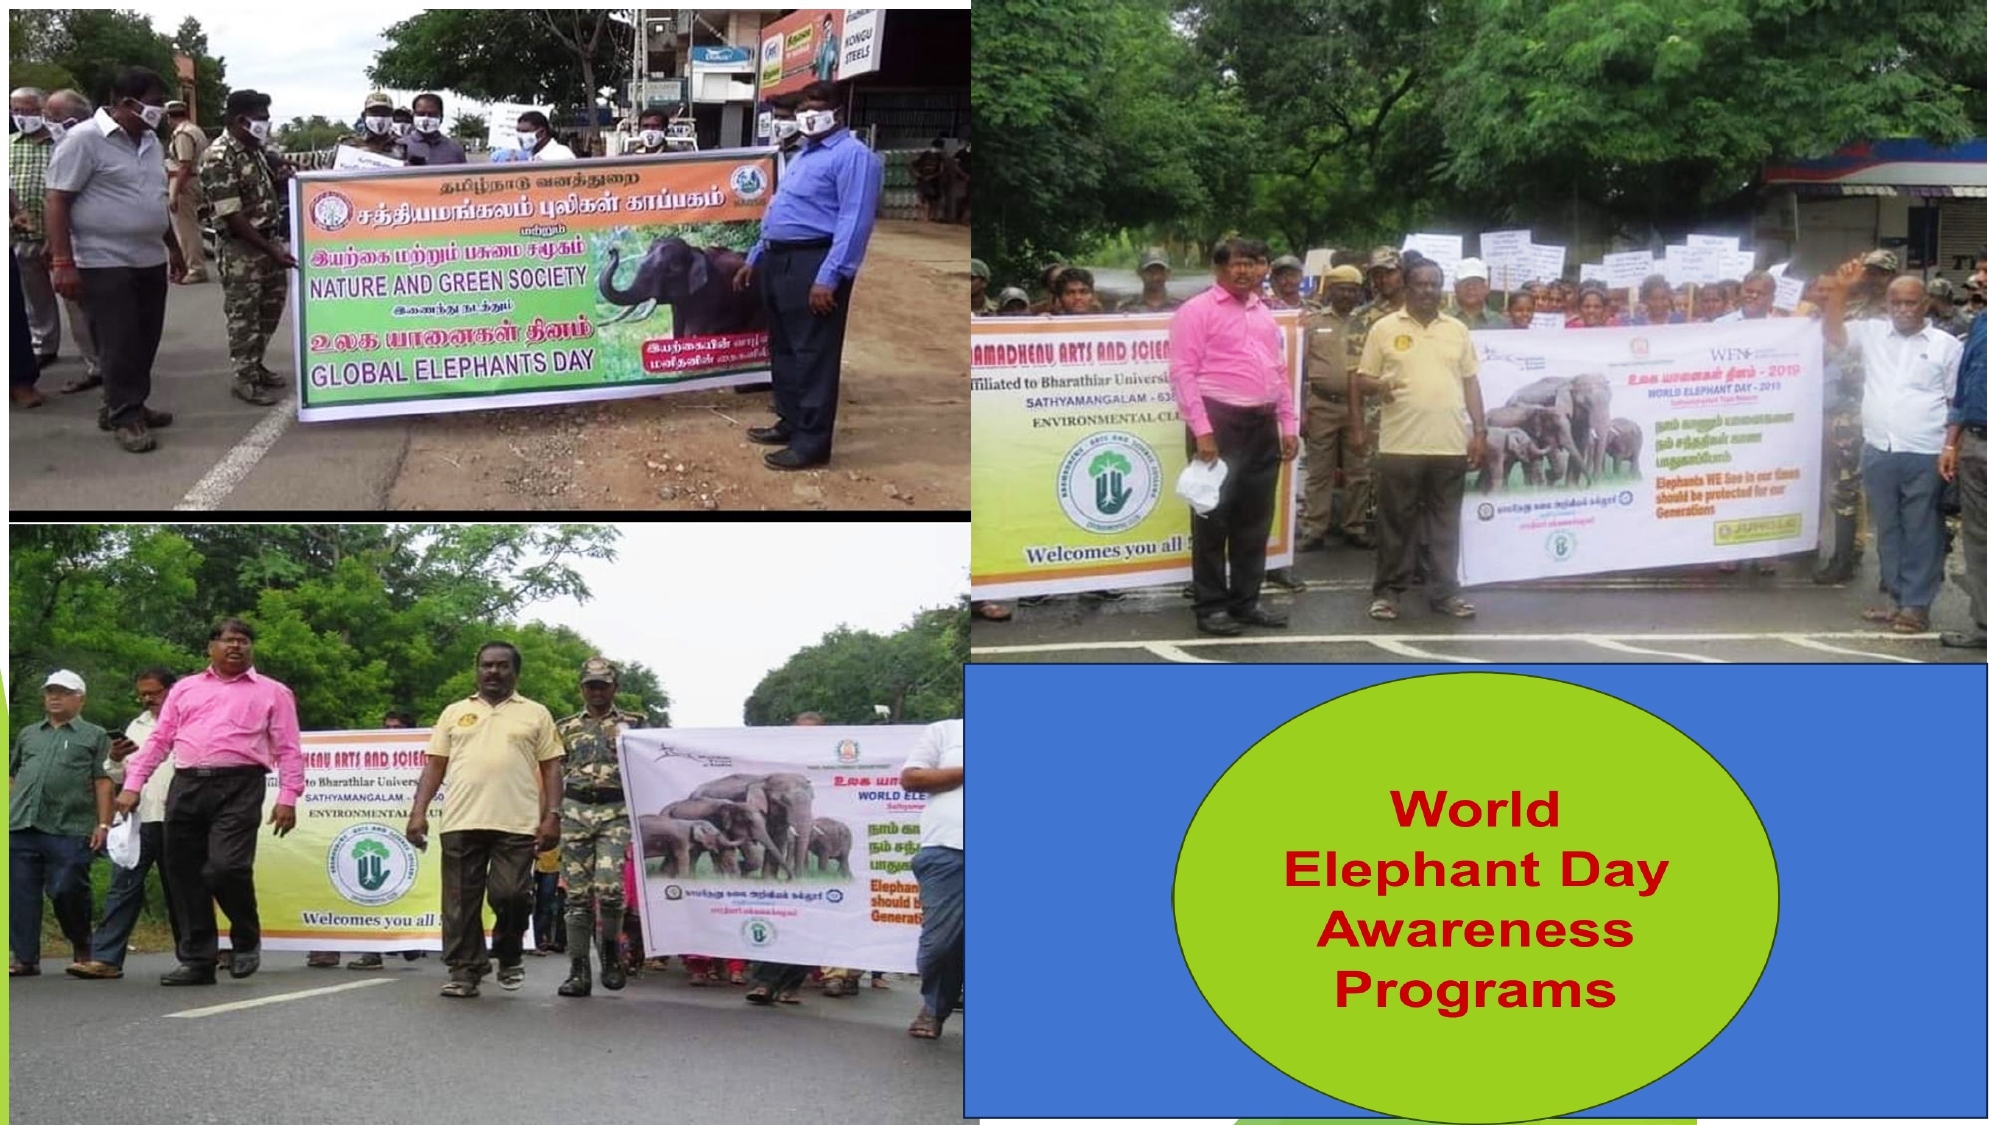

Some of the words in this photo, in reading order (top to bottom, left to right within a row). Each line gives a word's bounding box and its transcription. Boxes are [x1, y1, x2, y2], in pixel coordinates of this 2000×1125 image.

[844, 27, 873, 48] KONGU
[845, 45, 871, 65] STEELS
[440, 174, 530, 195] தமிழ்நாடு
[537, 171, 639, 189] வனத்துறை
[357, 195, 533, 229] சத்தியமங்கலம்
[540, 189, 619, 218] புலிகள்
[626, 185, 725, 212] காப்பகம்
[311, 246, 390, 270] இயற்கை
[395, 242, 458, 267] மற்றும்
[465, 243, 521, 262] பசுமை
[527, 235, 585, 259] சமூகம்
[310, 276, 387, 298] NATURE
[393, 274, 433, 295] AND
[439, 271, 504, 293] GREEN
[509, 266, 587, 289] SOCIETY
[310, 331, 380, 353] உலக
[386, 320, 521, 348] யானைகள்
[525, 314, 593, 346] தினம்
[971, 343, 1054, 365] AMADHENU
[1059, 341, 1092, 363] ARTS
[1097, 341, 1127, 361] AND
[1132, 340, 1170, 360] SCIEN
[311, 362, 408, 387] GLOBAL
[415, 353, 547, 380] ELEPHANTS
[554, 349, 594, 371] DAY
[971, 376, 1022, 391] ffiliated
[1024, 377, 1038, 389] to
[1042, 373, 1113, 388] Bharathiar
[1114, 371, 1169, 386] Universi
[1648, 388, 1682, 399] WORLD
[1684, 384, 1732, 396] ELEPHANT
[1734, 382, 1753, 393] DAY
[1026, 392, 1146, 408] SATHYAMANGALAM
[1033, 412, 1153, 428] ENVIRONMENTAL
[1656, 476, 1704, 490] Elephants
[1706, 472, 1723, 486] WE
[1656, 491, 1689, 504] should
[1691, 490, 1703, 501] be
[1705, 485, 1753, 503] protected
[1656, 505, 1715, 519] Generations
[1026, 545, 1120, 564] Welcomes
[1121, 542, 1156, 560] you
[1162, 536, 1182, 552] all
[335, 751, 361, 768] ARTS
[364, 751, 389, 767] AND
[393, 750, 428, 767] SCIEN
[305, 777, 316, 787] to
[318, 776, 376, 788] Bharathiar
[377, 776, 419, 788] Univers
[305, 793, 404, 802] SATHYAMANGALAM
[858, 791, 901, 801] WORLD
[870, 879, 921, 896] Elephan
[871, 894, 911, 909] should
[303, 912, 381, 926] Welcomes
[384, 916, 412, 930] you
[416, 913, 435, 927] all
[871, 909, 923, 925] Generati
